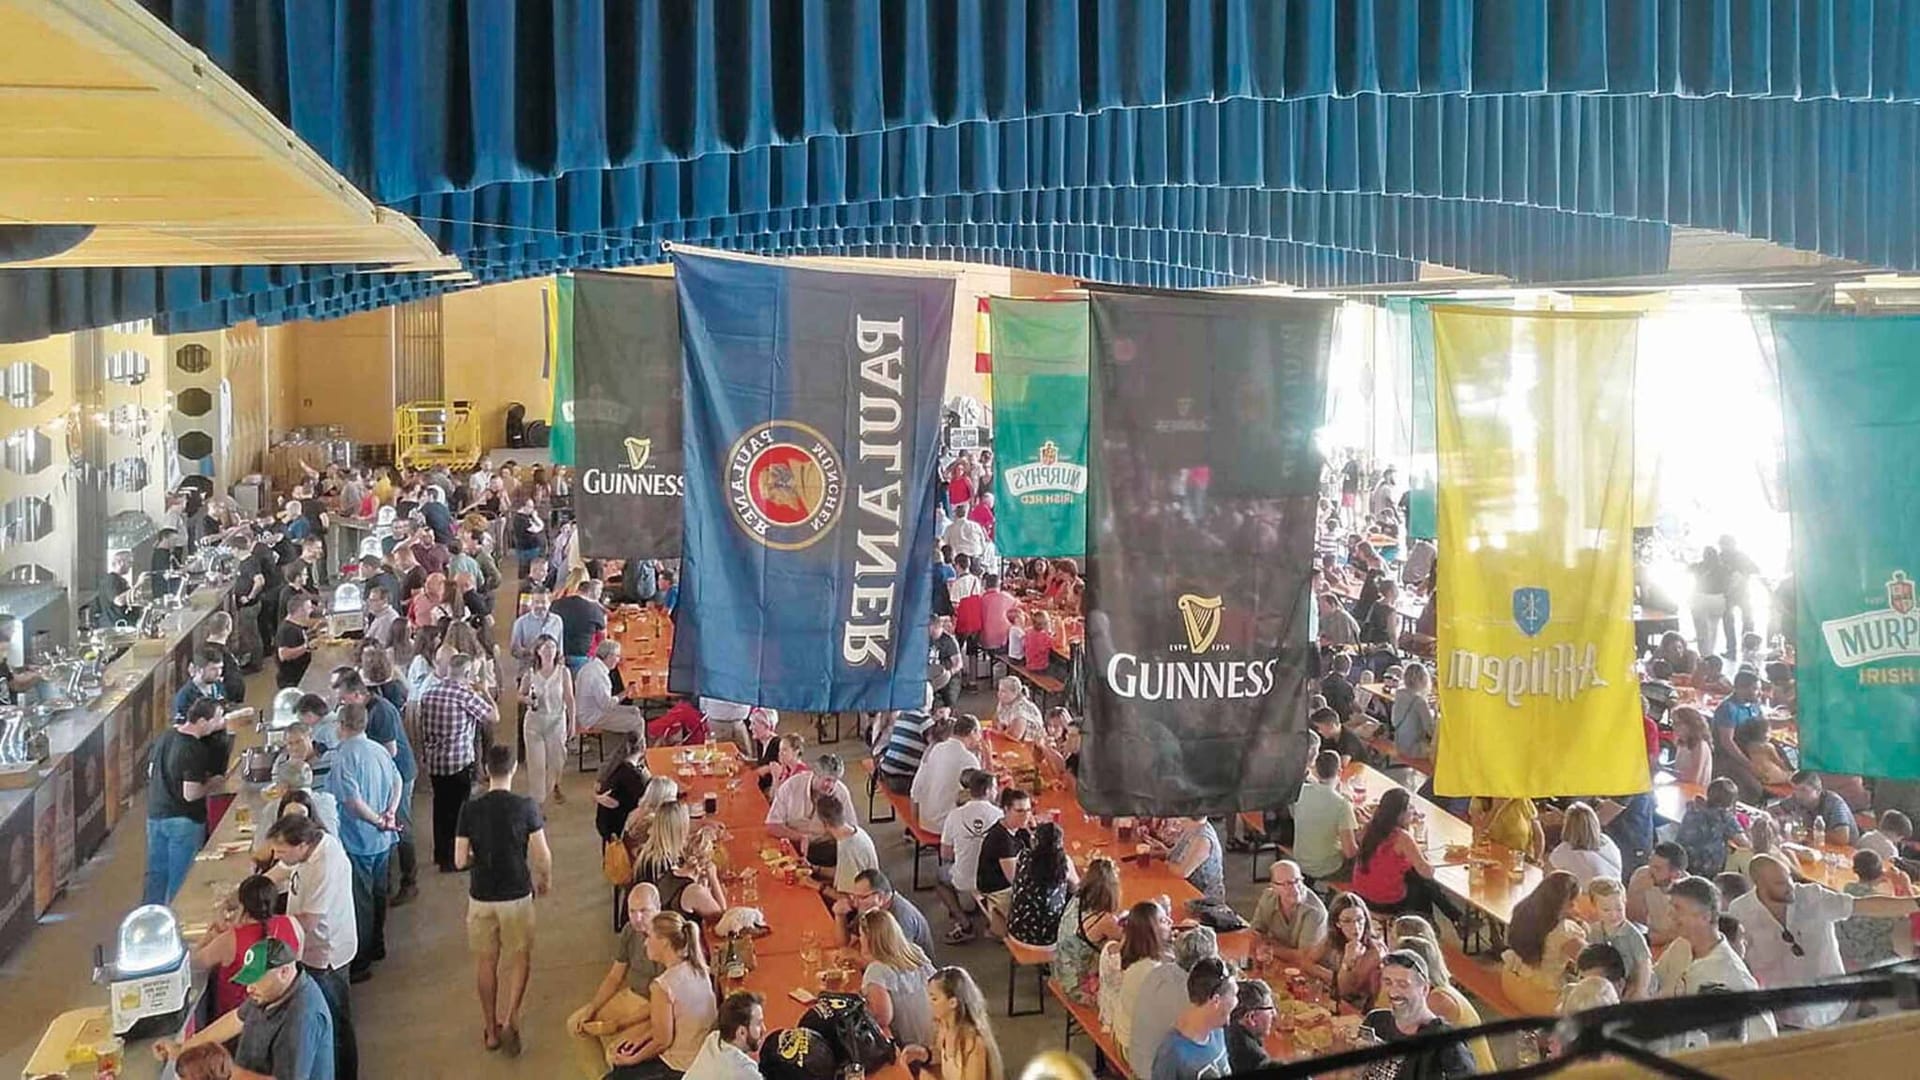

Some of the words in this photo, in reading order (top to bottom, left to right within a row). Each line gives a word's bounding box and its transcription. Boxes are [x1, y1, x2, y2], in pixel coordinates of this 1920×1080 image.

[1837, 616, 1920, 658] MURP
[1107, 653, 1280, 700] GUINNESS
[1859, 667, 1915, 684] IRISH
